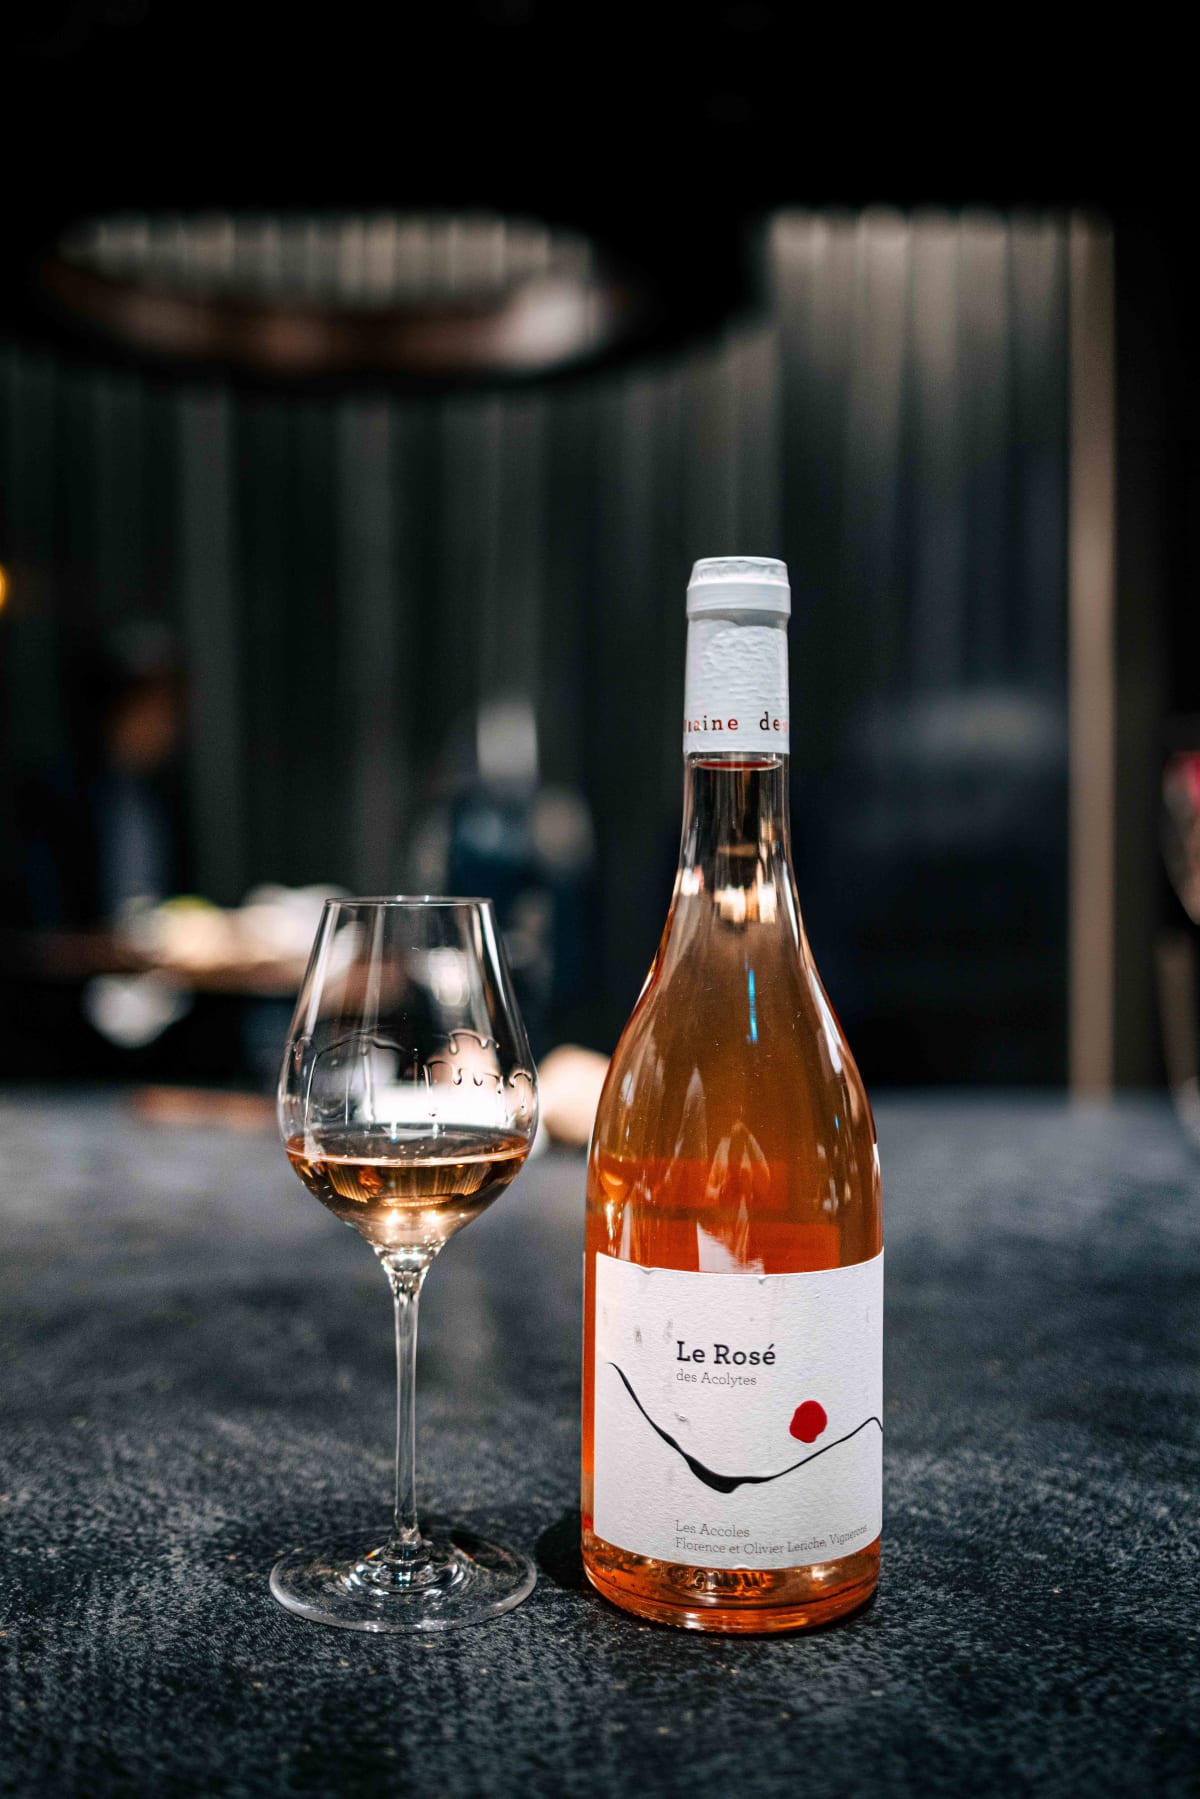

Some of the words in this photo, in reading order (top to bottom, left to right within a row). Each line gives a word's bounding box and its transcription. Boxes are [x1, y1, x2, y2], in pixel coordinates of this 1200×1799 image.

[676, 1340, 706, 1363] Le
[713, 1343, 776, 1365] Rosé
[676, 1368, 698, 1383] des
[701, 1372, 757, 1388] Acolytes
[675, 1519, 697, 1534] Les
[699, 1523, 751, 1538] Accoles
[675, 1536, 726, 1554] Florence
[728, 1543, 741, 1554] et
[743, 1541, 785, 1555] Olivier
